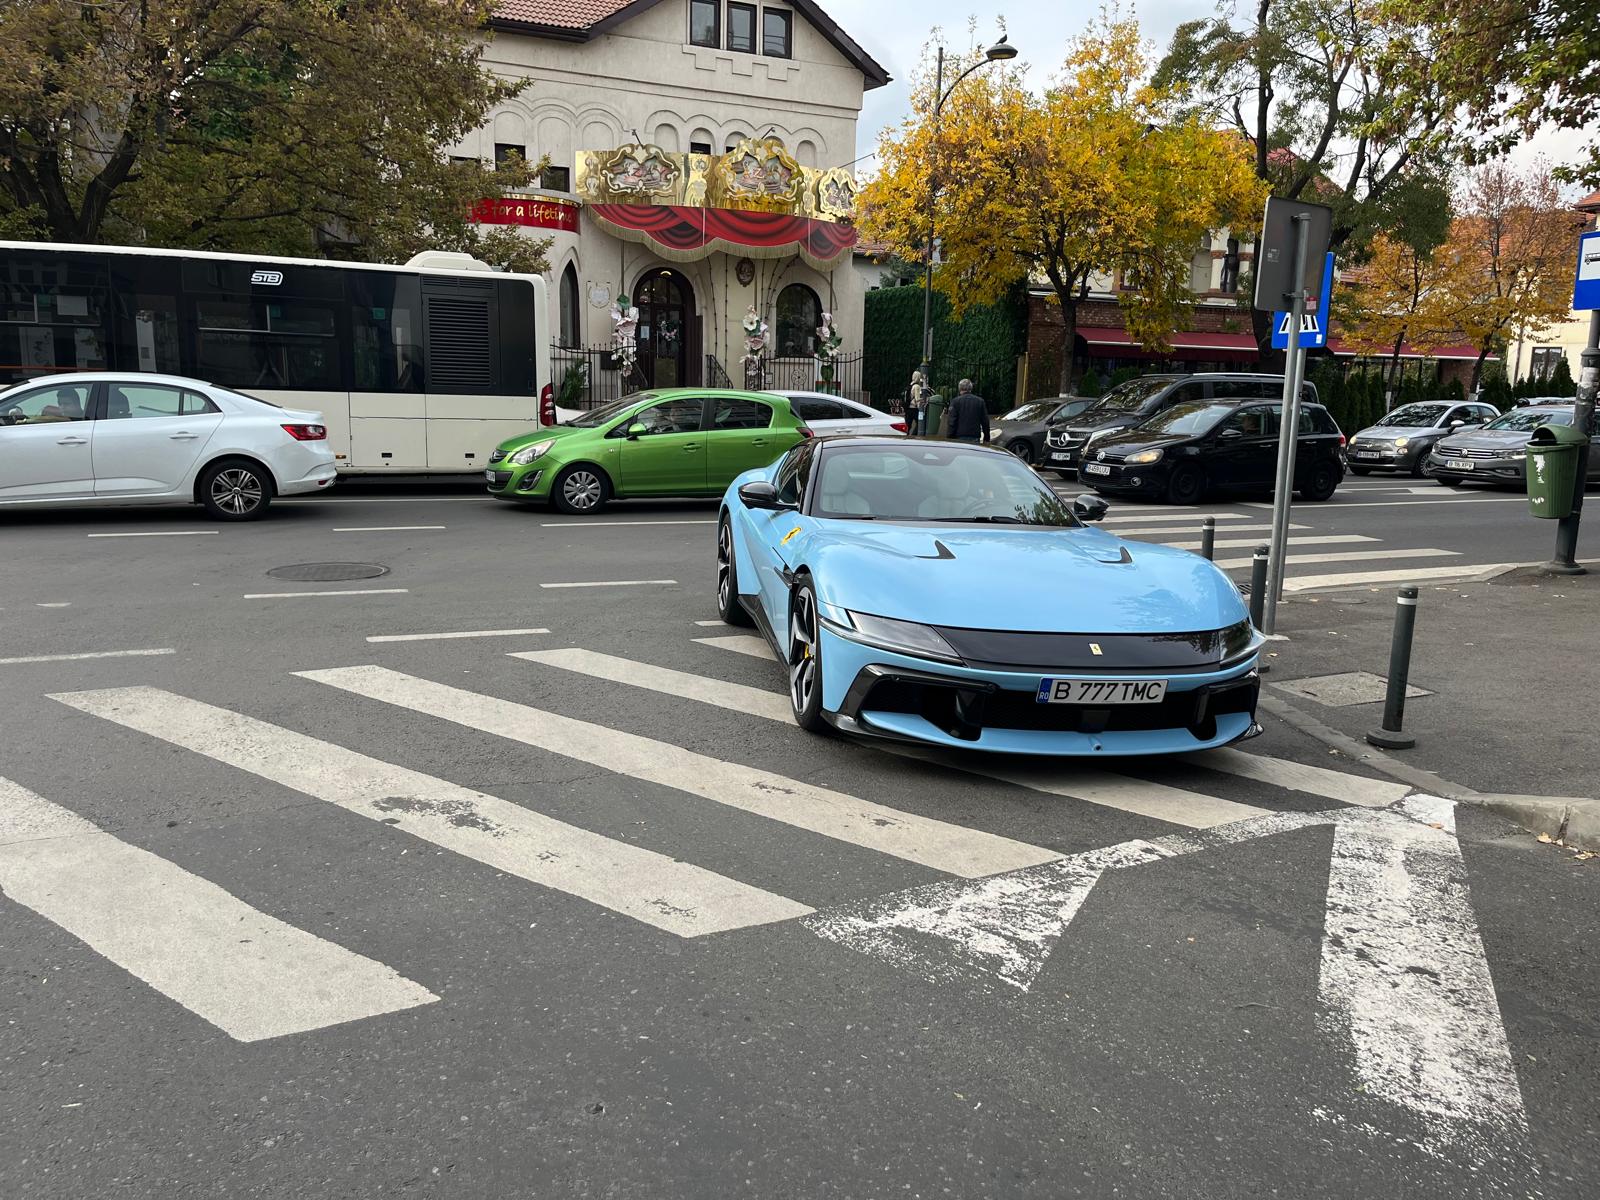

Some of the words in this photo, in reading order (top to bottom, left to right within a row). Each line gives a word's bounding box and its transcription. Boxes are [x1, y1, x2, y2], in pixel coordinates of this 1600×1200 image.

[515, 205, 525, 217] a
[251, 272, 280, 283] STB
[1053, 681, 1072, 700] B
[1077, 682, 1119, 701] 777
[1121, 682, 1162, 701] TMC
